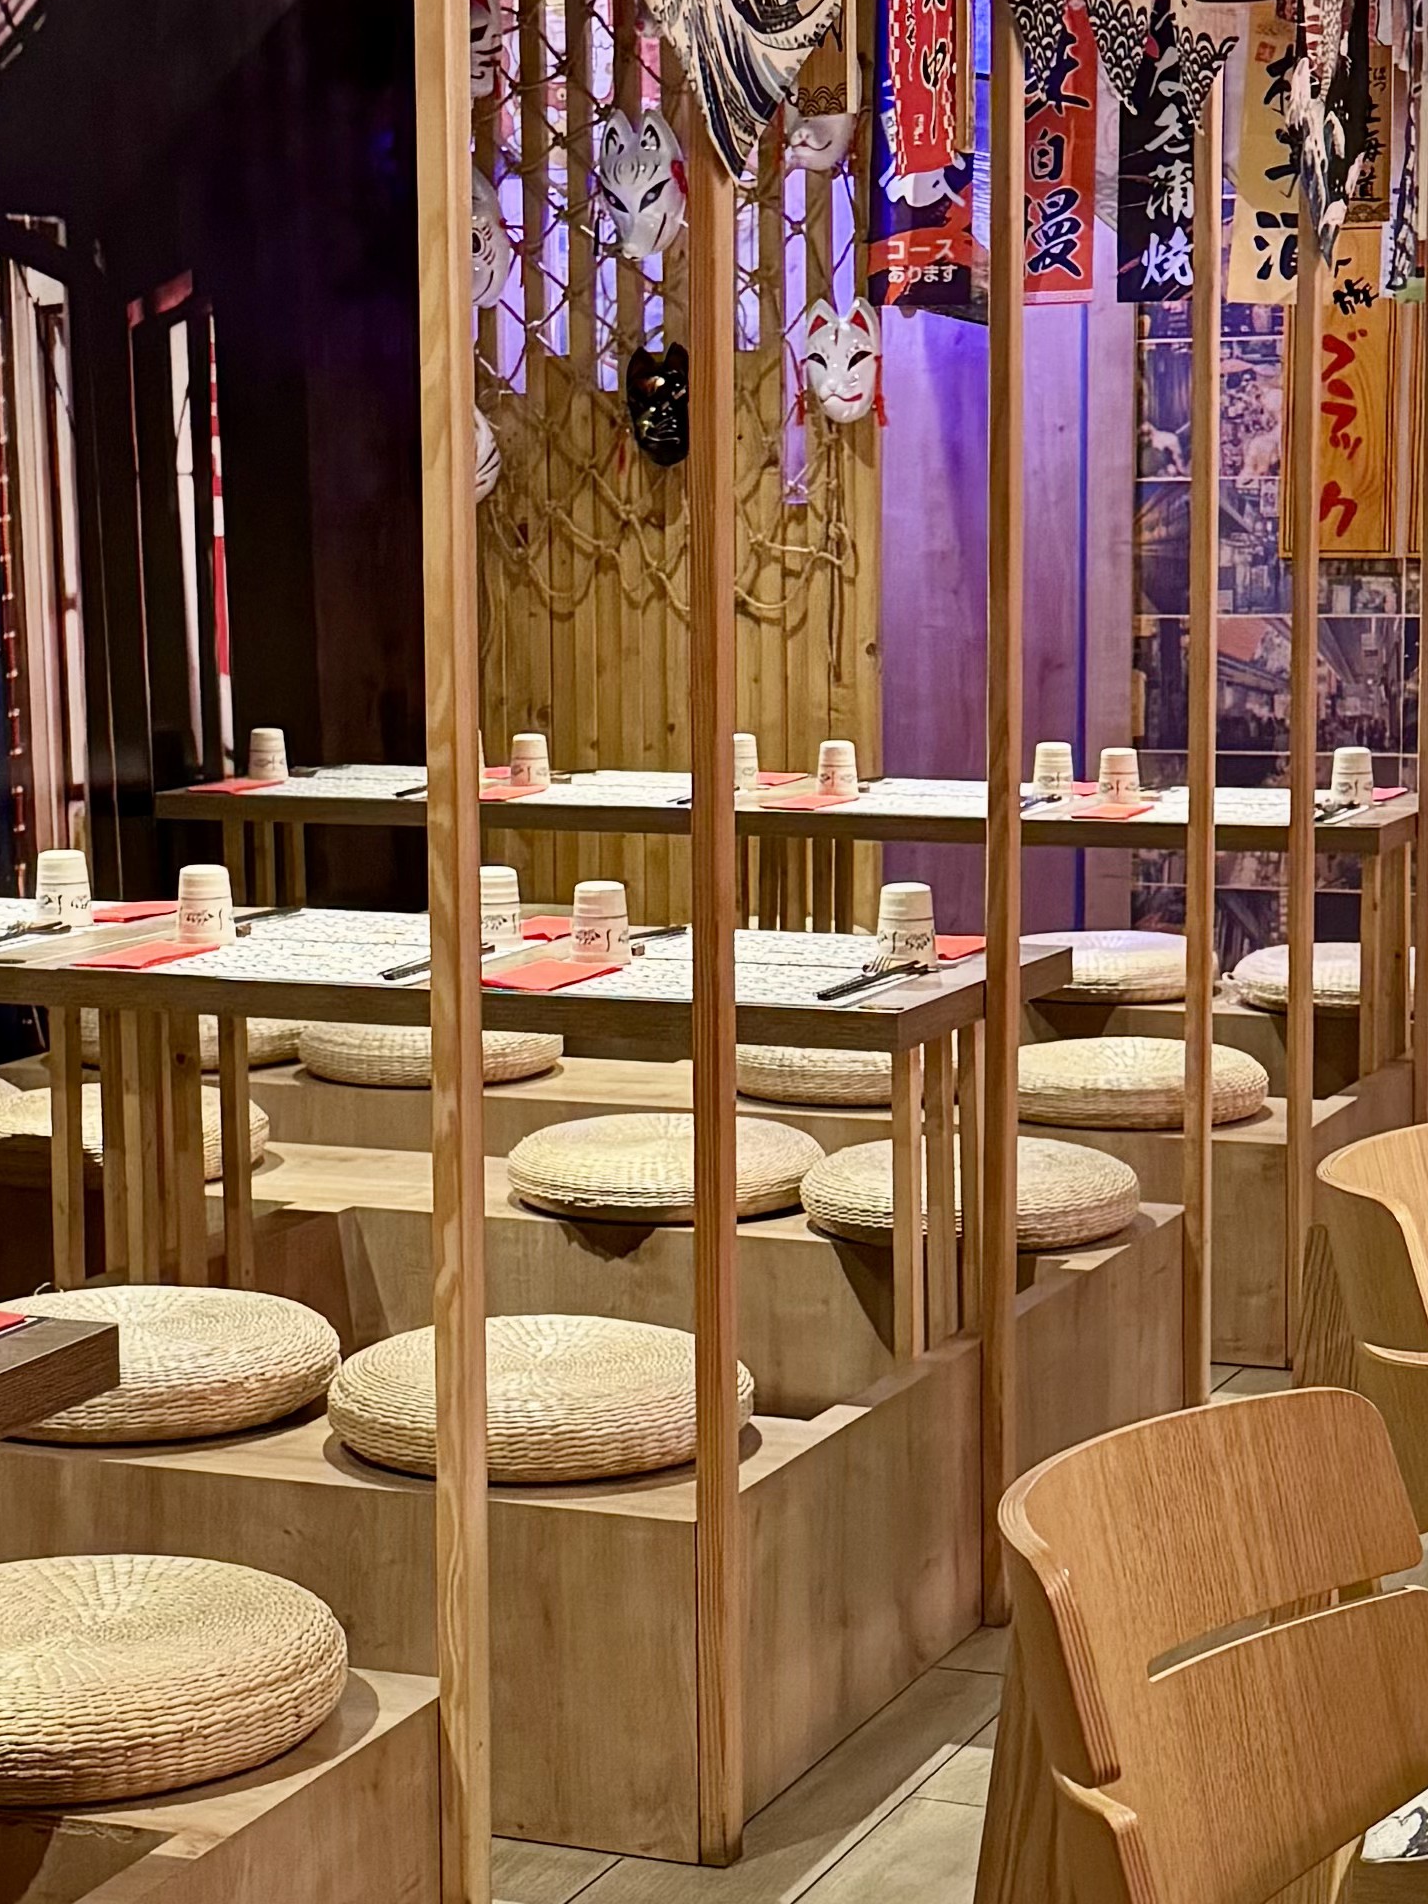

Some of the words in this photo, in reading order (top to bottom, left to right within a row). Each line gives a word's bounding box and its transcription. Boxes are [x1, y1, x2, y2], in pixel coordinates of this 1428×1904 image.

[1141, 4, 1194, 290] なぎ蒲焼
[887, 238, 954, 261] コース
[888, 264, 958, 284] あります
